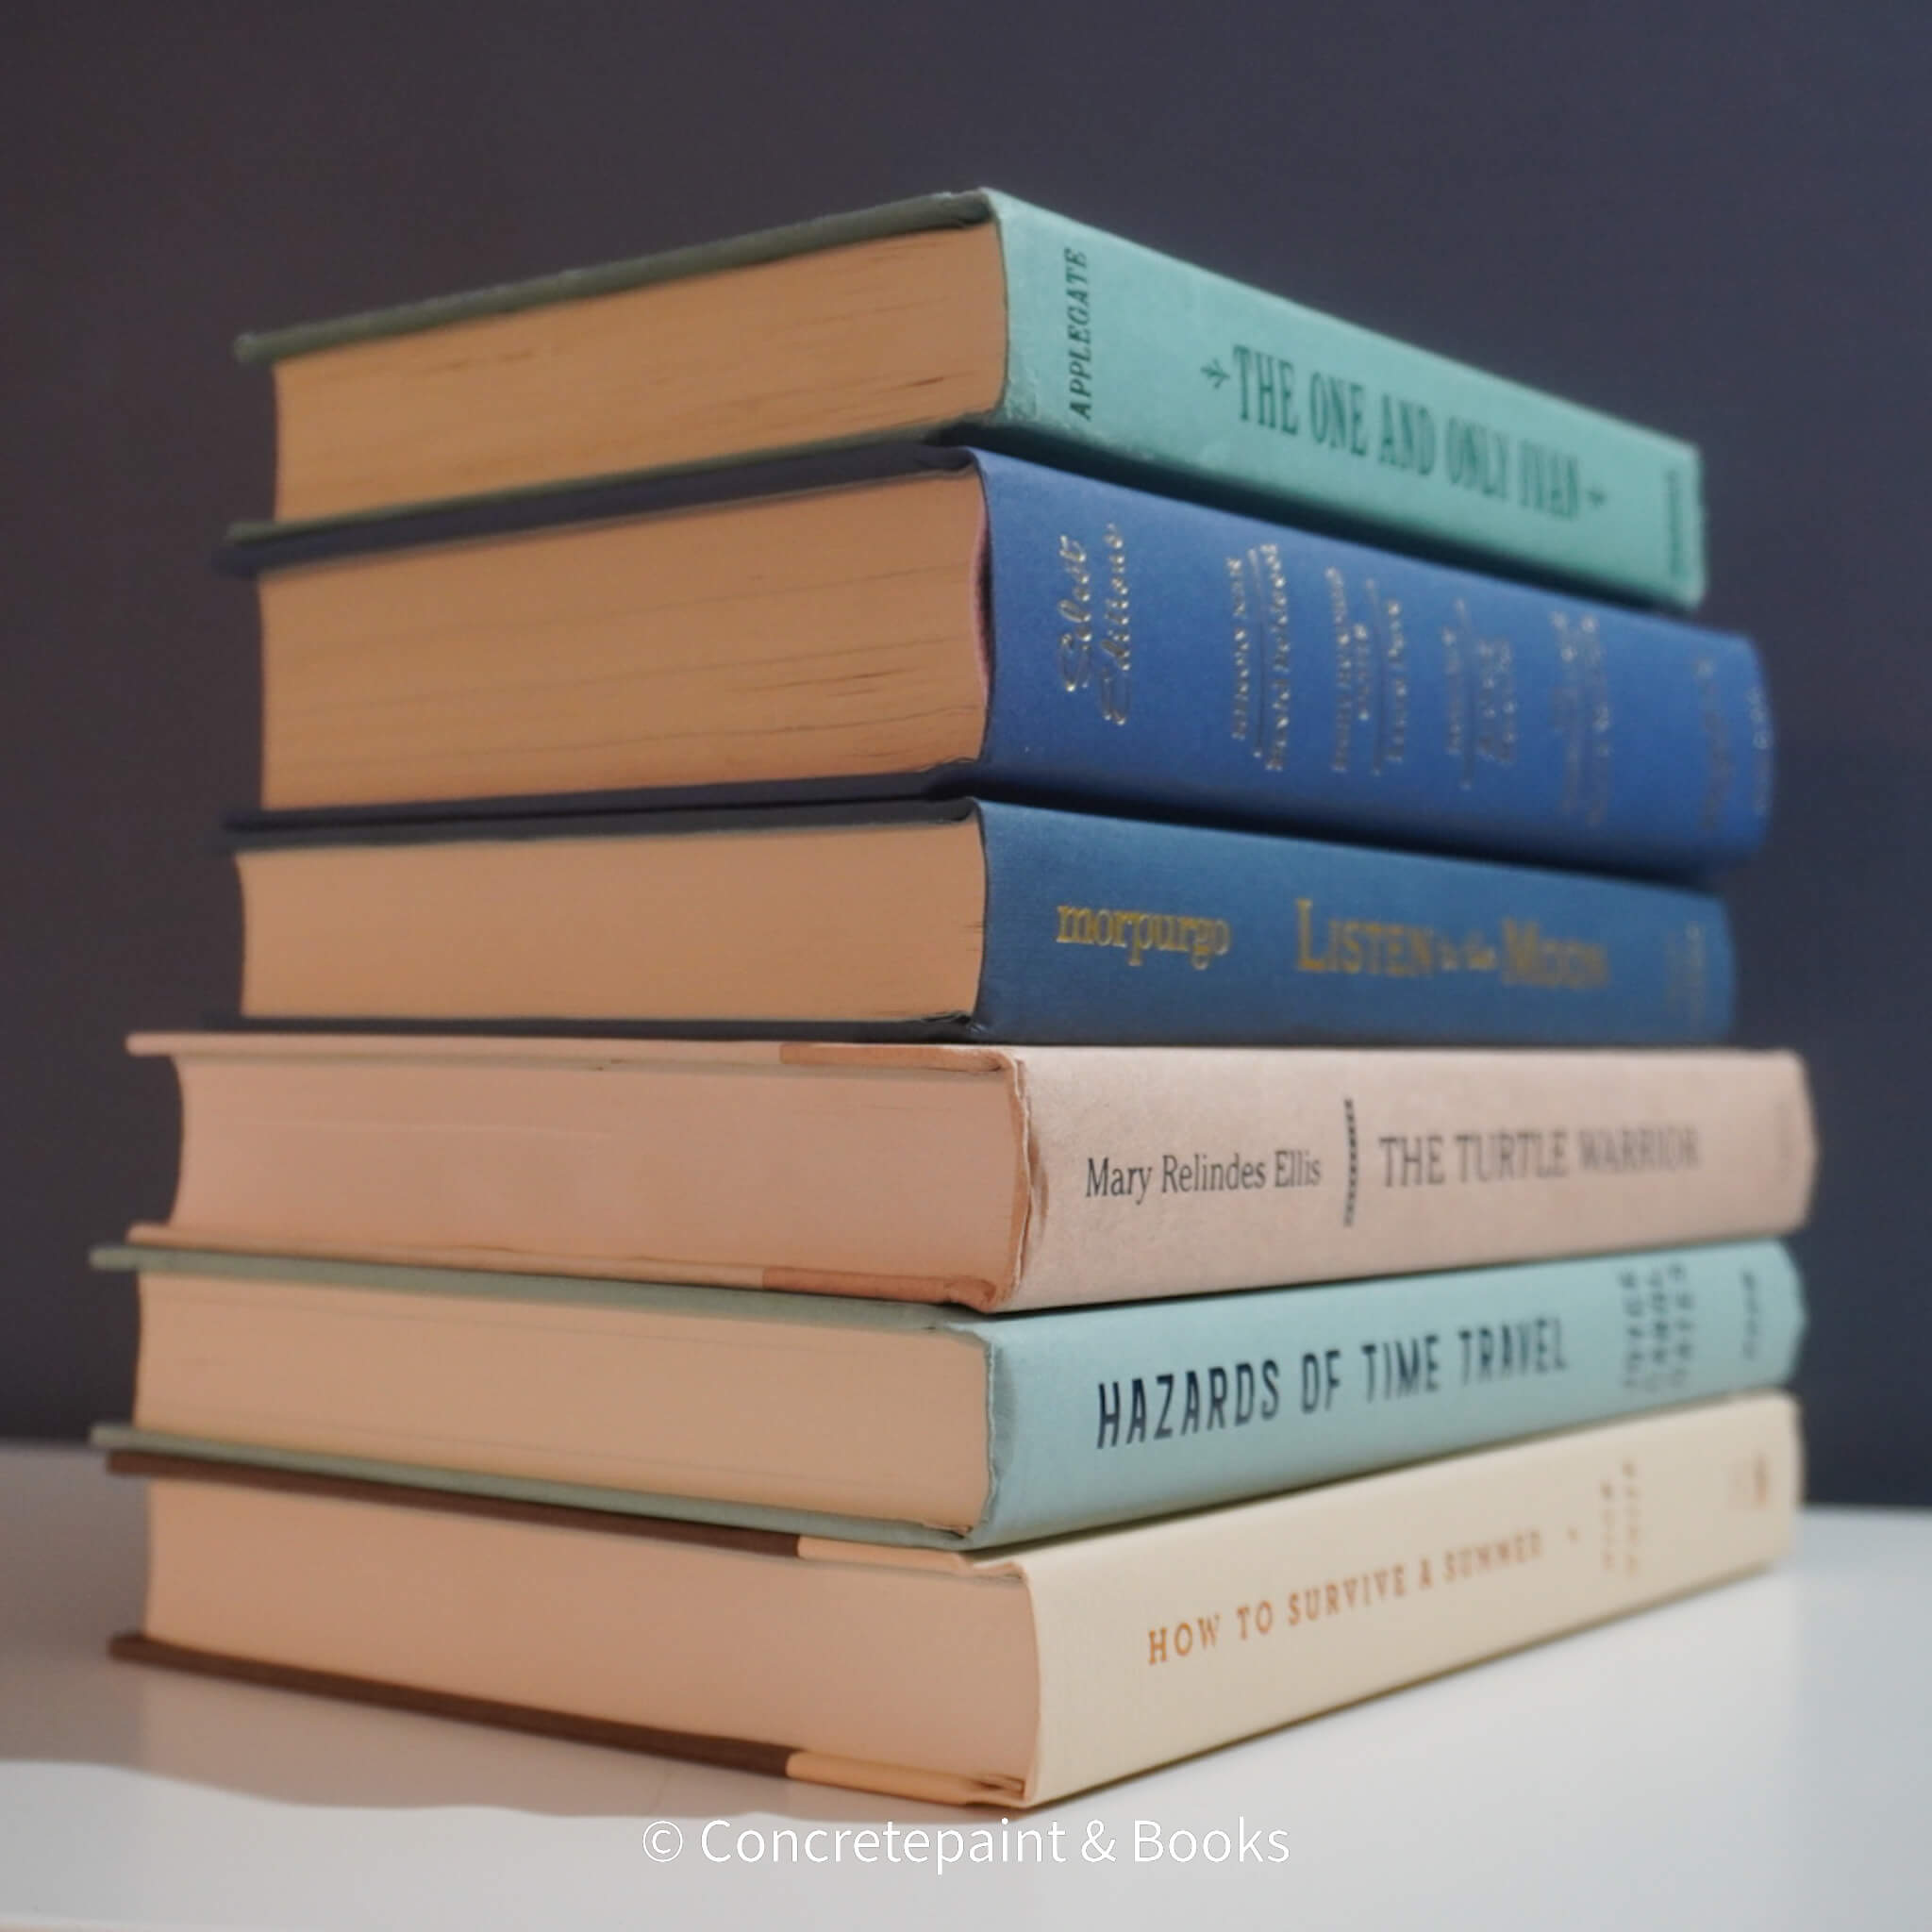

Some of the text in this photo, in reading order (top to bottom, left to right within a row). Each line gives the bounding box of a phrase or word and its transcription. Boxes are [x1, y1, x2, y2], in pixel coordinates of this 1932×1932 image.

[1064, 247, 1091, 421] APPLEGATE
[1233, 344, 1298, 436] THE
[1310, 372, 1367, 457] ONE
[1378, 393, 1435, 476] AND
[1445, 416, 1509, 502] ONLY
[1056, 905, 1231, 970] morpurgo
[1086, 1149, 1322, 1206] Mary Relindes Ellis
[1378, 1135, 1445, 1188] THE
[1454, 1127, 1569, 1184] TURTLE
[1097, 1358, 1281, 1450] HAZARDS
[1301, 1348, 1341, 1415] OF
[1361, 1333, 1441, 1405] TIME
[1458, 1315, 1569, 1387] TRAVEL
[1148, 1612, 1222, 1665] HOW
[1236, 1600, 1274, 1641] TO
[1287, 1562, 1406, 1627] SURVIVE
[1418, 1557, 1434, 1591] A
[1441, 1526, 1543, 1585] SUMMER
